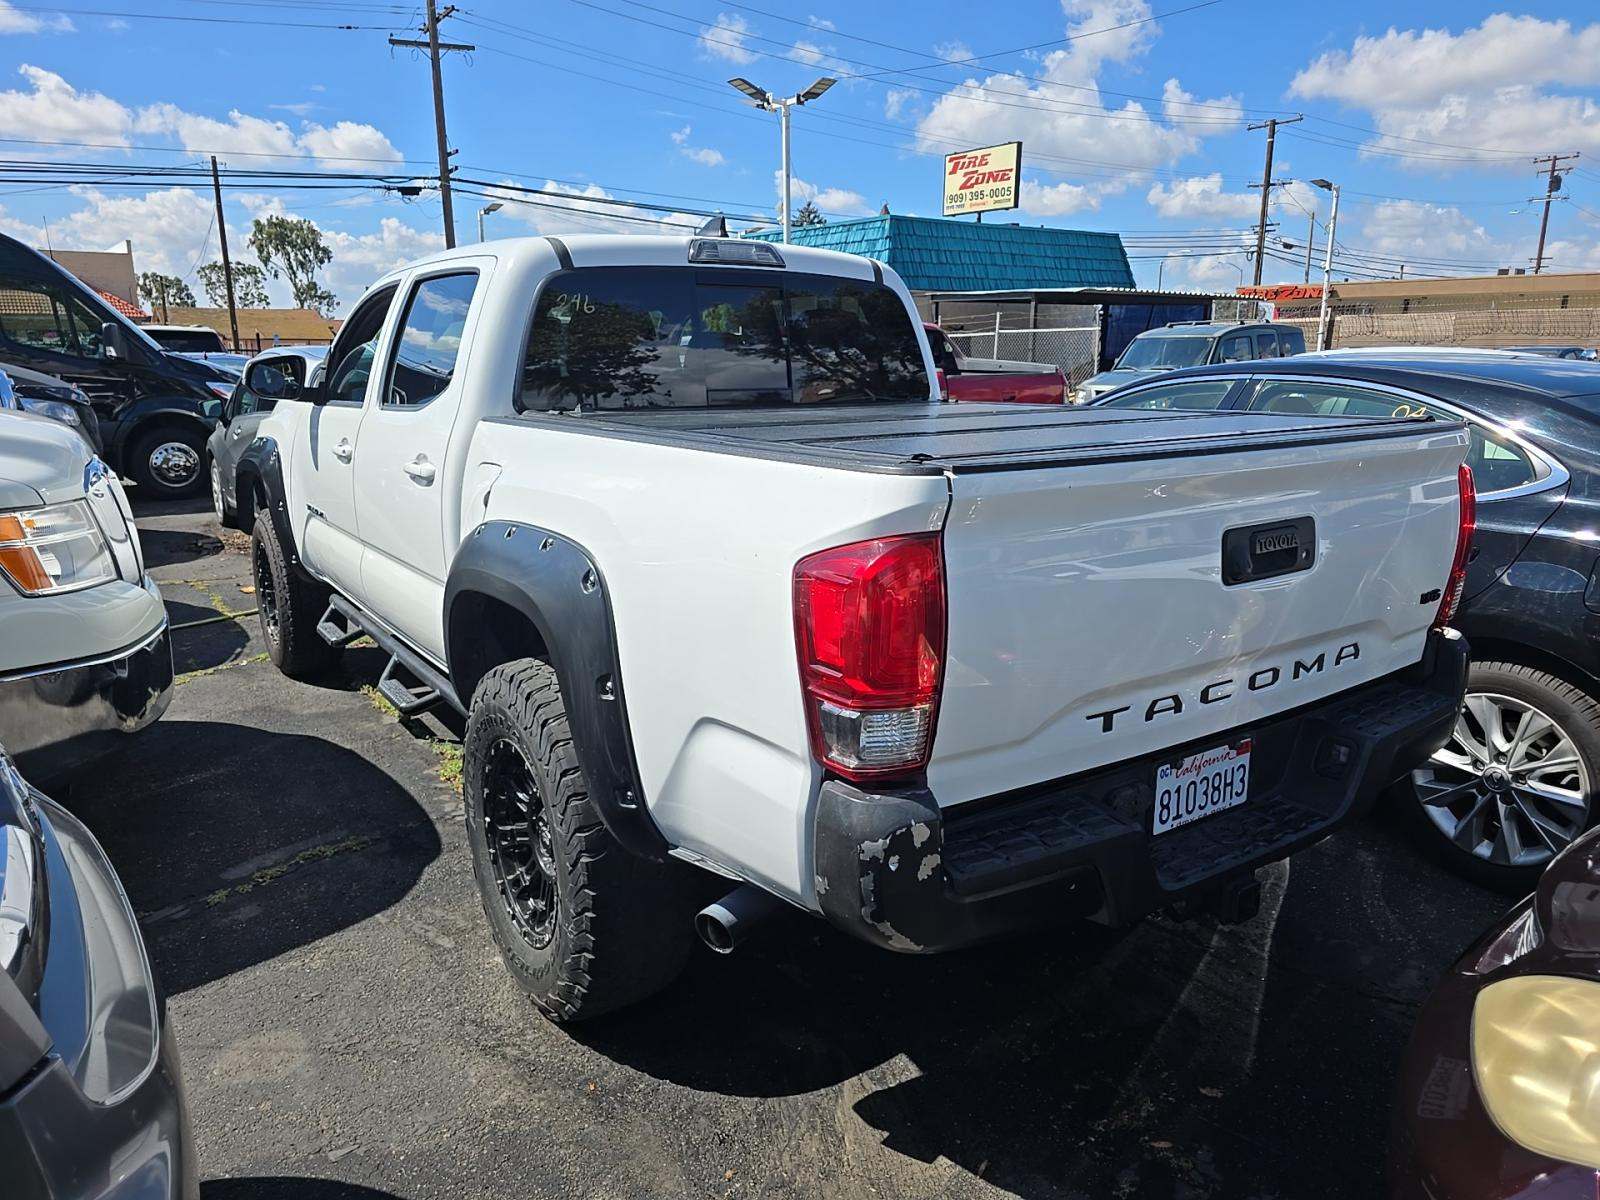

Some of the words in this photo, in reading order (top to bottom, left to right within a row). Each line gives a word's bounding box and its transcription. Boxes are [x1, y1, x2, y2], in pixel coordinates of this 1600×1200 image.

[948, 153, 991, 175] TIRE
[959, 168, 1013, 190] ZONE
[946, 192, 967, 205] (909)
[969, 186, 1012, 201] 395-0005
[1258, 533, 1299, 551] TOYOTA
[1085, 642, 1361, 734] TACOMA
[1158, 763, 1247, 825] 81038H3
